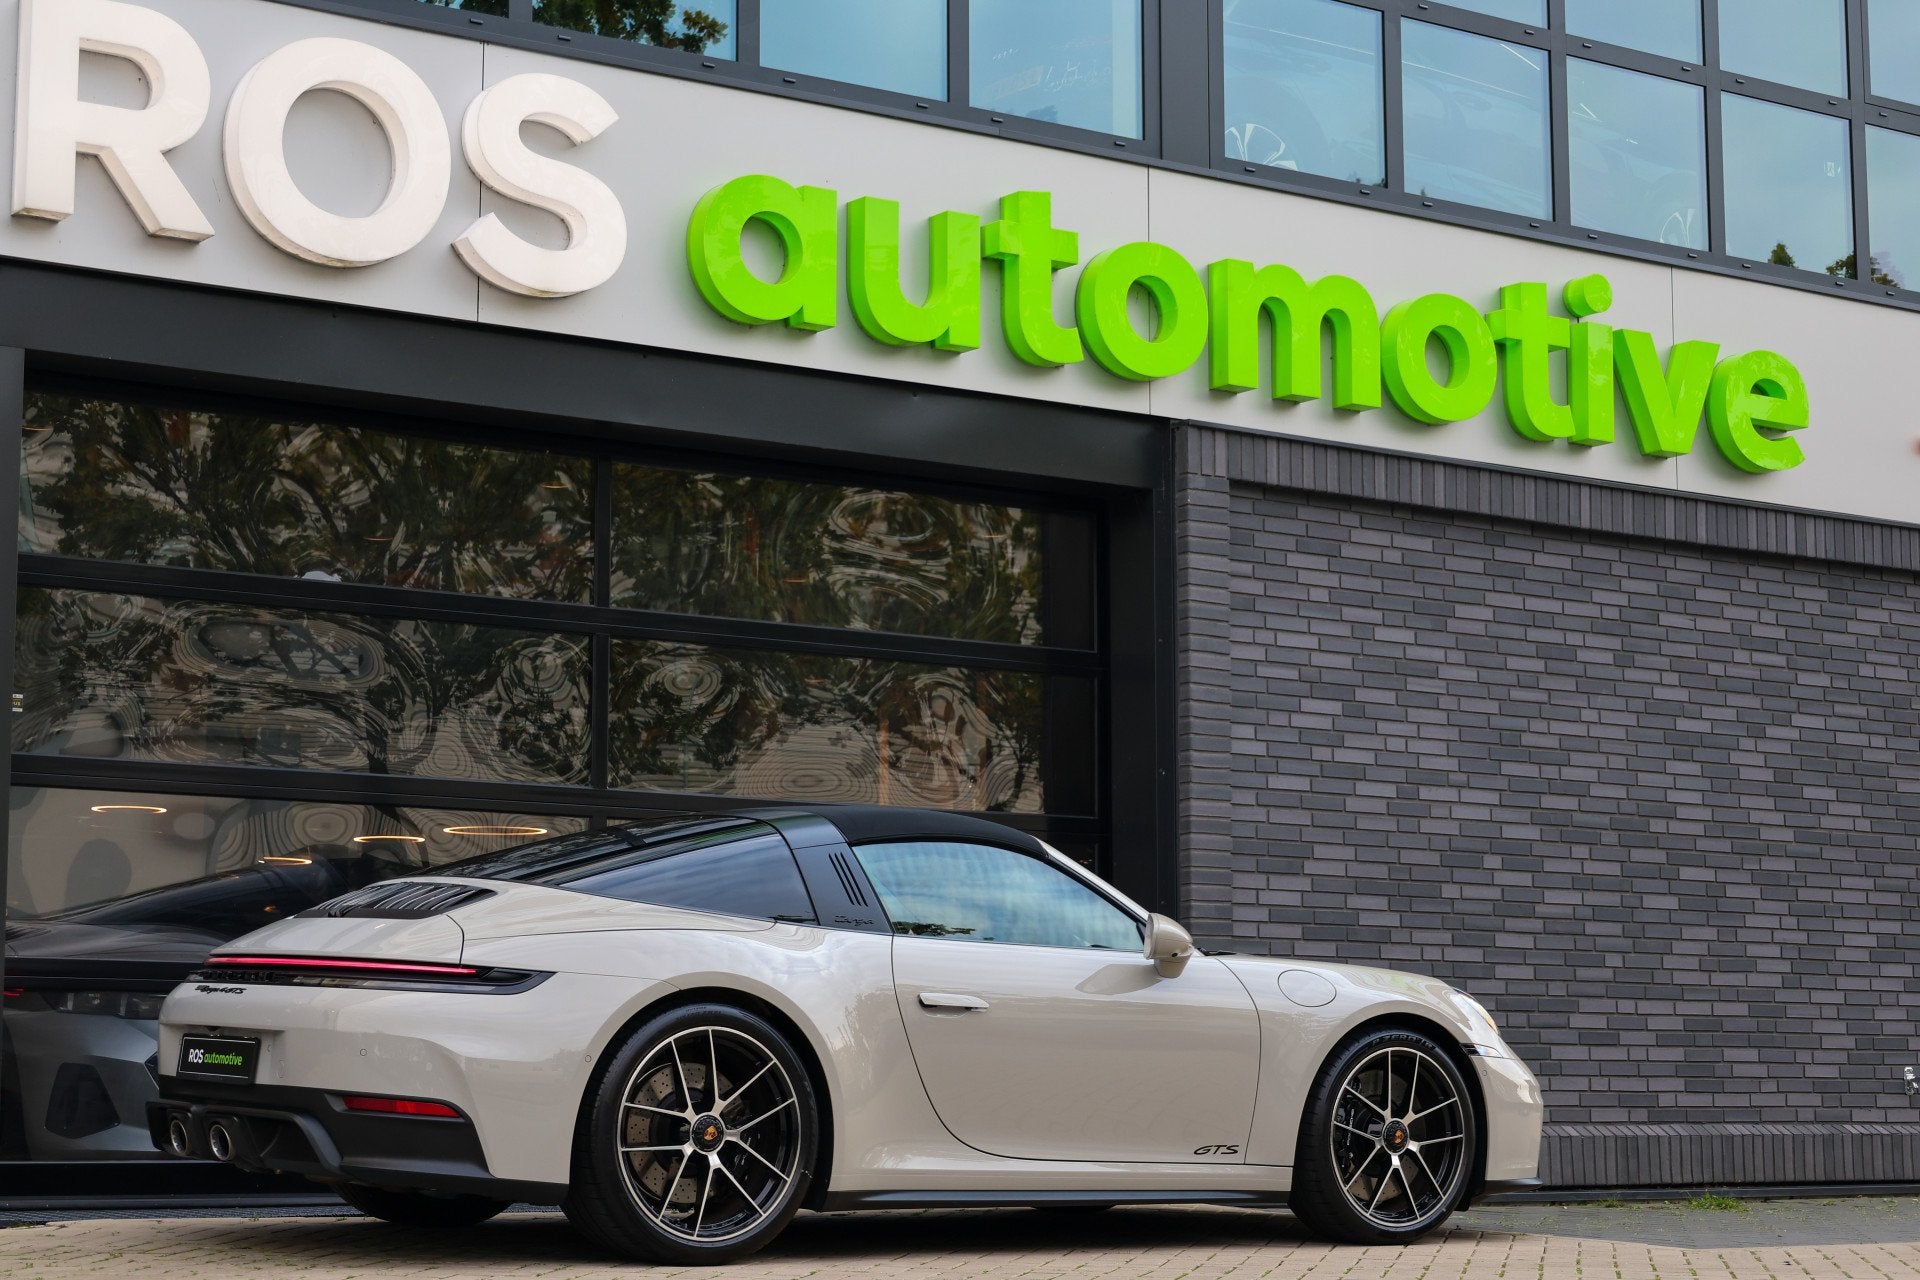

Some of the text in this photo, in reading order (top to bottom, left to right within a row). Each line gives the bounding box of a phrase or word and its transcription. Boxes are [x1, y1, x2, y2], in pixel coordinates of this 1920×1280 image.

[11, 0, 1809, 472] ROS automotive
[188, 1048, 243, 1066] ROS automotive
[1193, 1144, 1239, 1155] GTS
